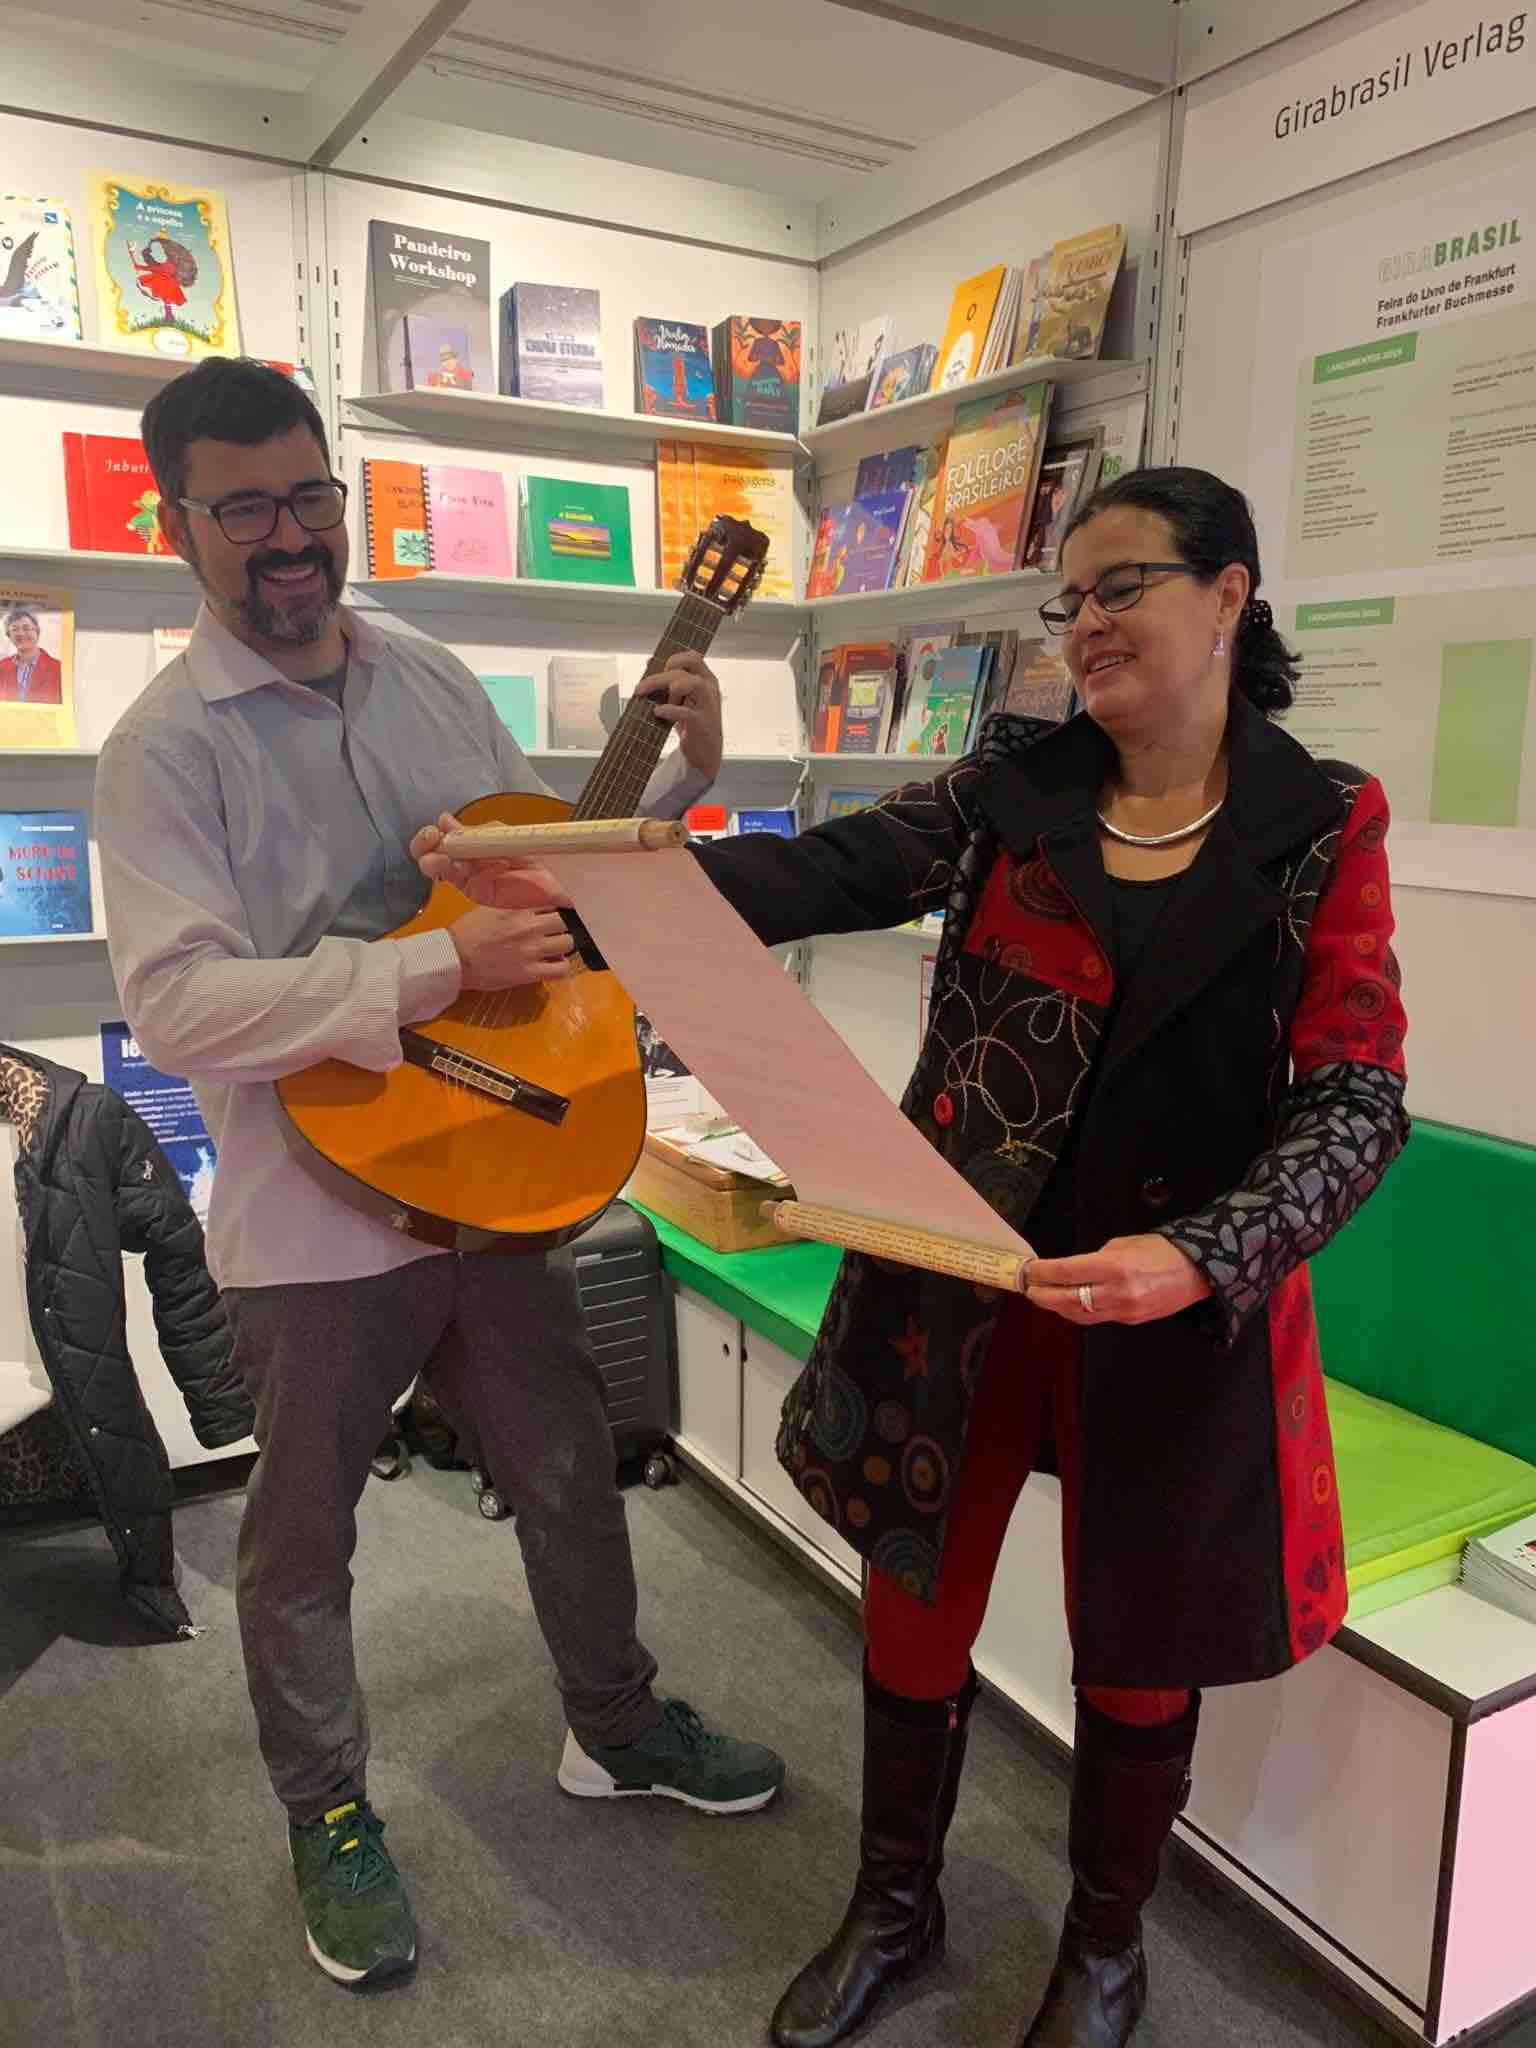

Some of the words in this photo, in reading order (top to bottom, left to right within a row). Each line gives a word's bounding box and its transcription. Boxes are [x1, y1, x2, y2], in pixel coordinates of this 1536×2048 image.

[1275, 53, 1411, 139] Girabrasil
[1424, 13, 1528, 77] Verlag
[388, 253, 477, 288] Workshop
[393, 233, 472, 262] Pandeiro
[1376, 303, 1441, 329] Frankfurter
[1444, 282, 1514, 311] Buchmesse
[1377, 296, 1403, 313] Feira
[1406, 289, 1418, 304] do
[1421, 284, 1445, 300] Livro
[1448, 278, 1461, 292] de
[1464, 264, 1516, 288] Frankfurt
[947, 438, 1026, 492] FOLCLORE
[944, 466, 1025, 514] BRASILEIRO
